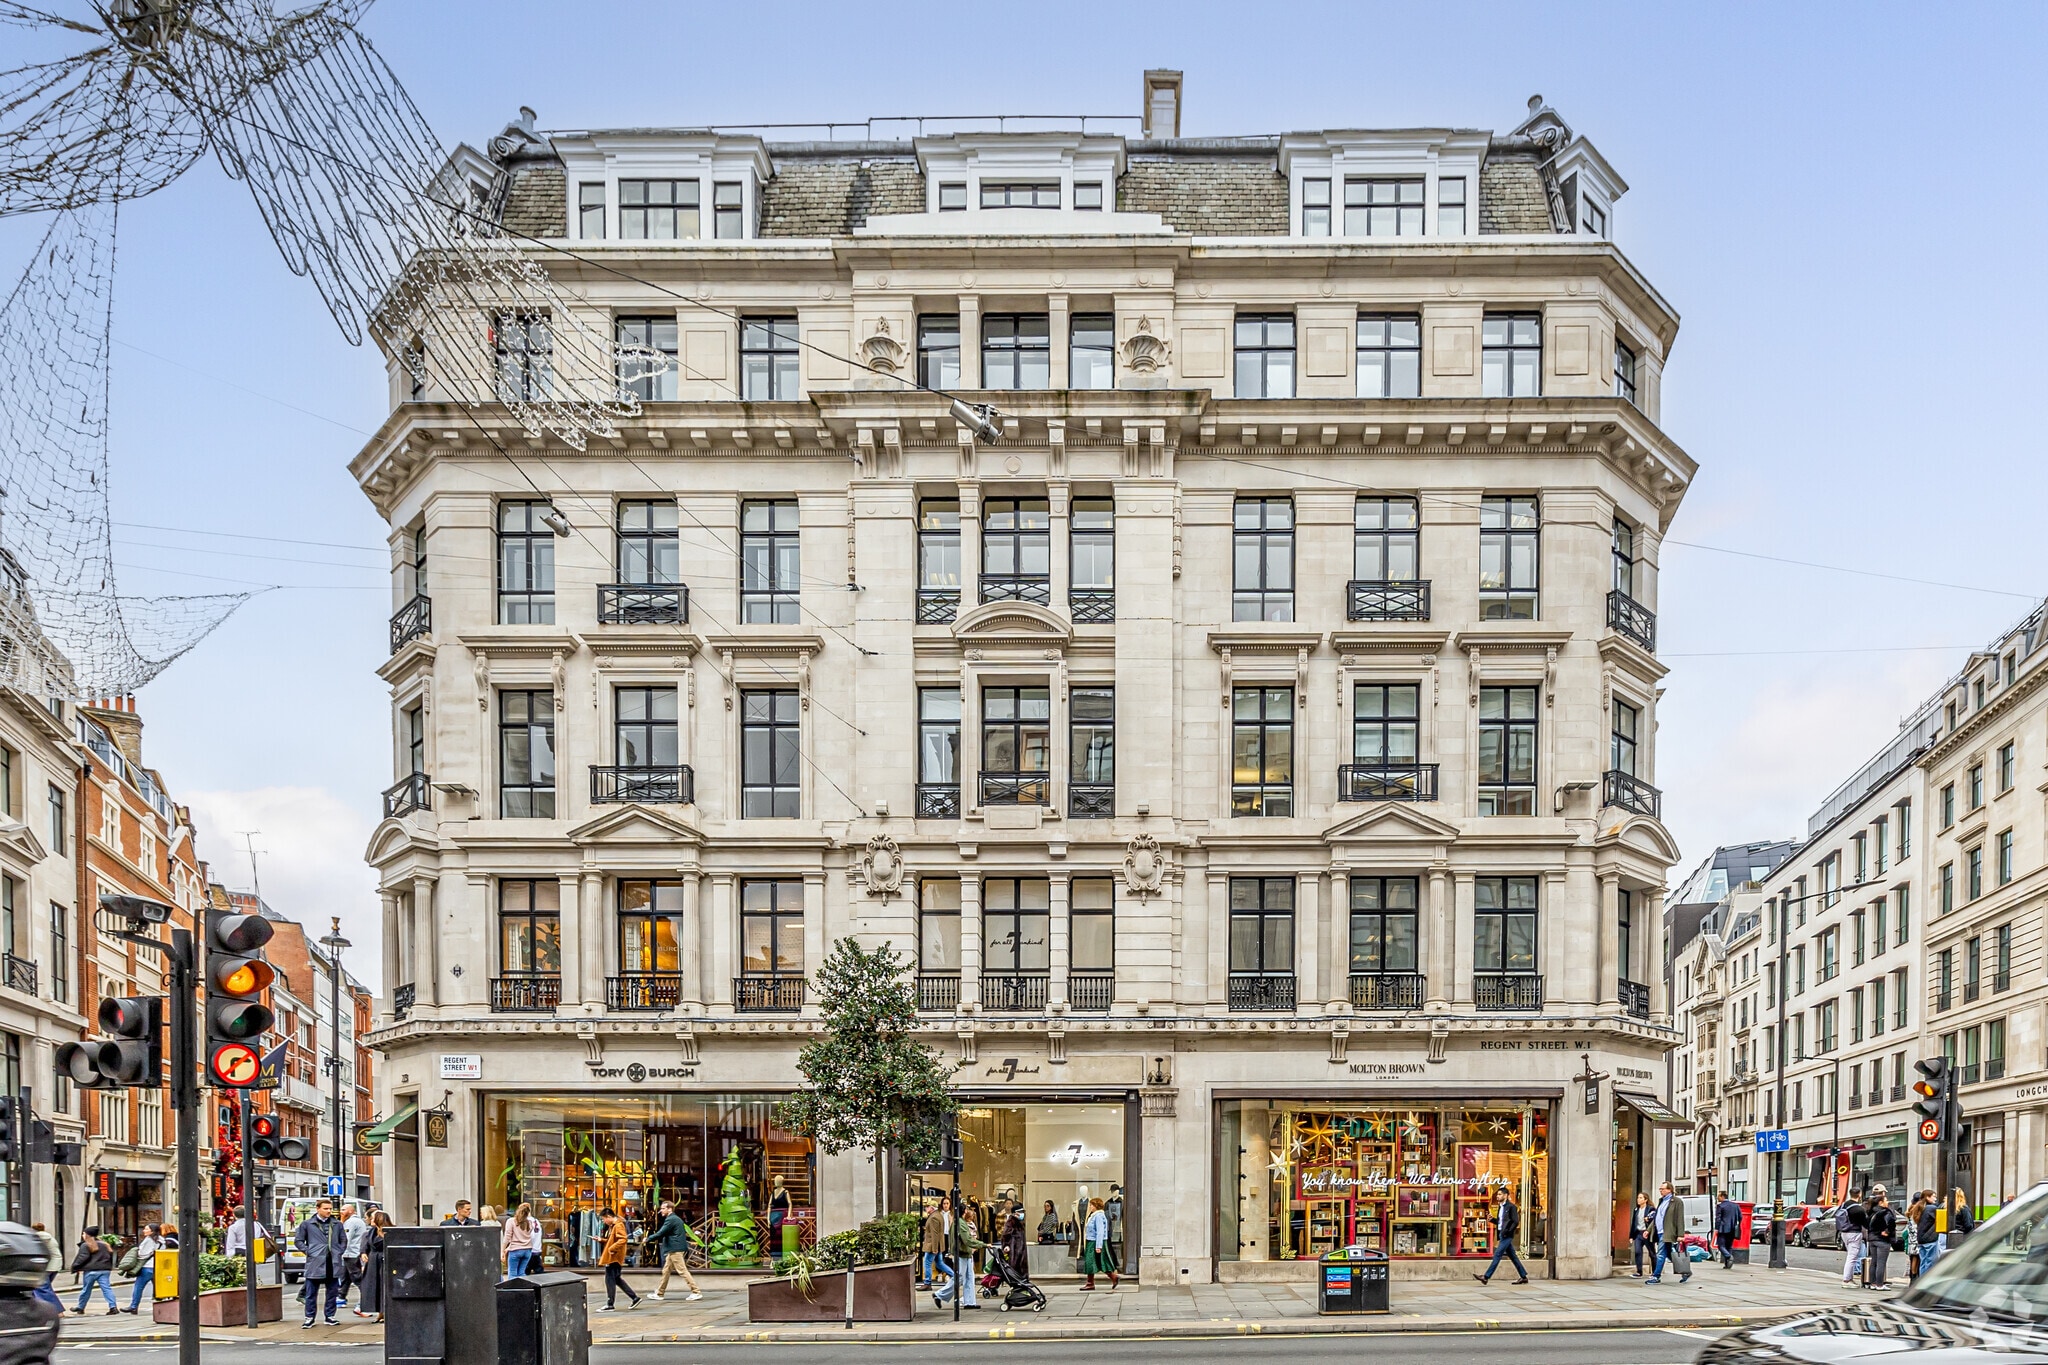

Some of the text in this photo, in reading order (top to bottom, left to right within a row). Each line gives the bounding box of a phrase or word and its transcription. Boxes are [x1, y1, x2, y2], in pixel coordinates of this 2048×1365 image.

[1481, 1041, 1522, 1049] REGENT
[591, 1068, 694, 1077] TORY BURCH
[1003, 1059, 1018, 1082] 7
[1349, 1064, 1425, 1073] MOLTON BROWN
[1302, 1171, 1512, 1191] You know them. We know gifting.
